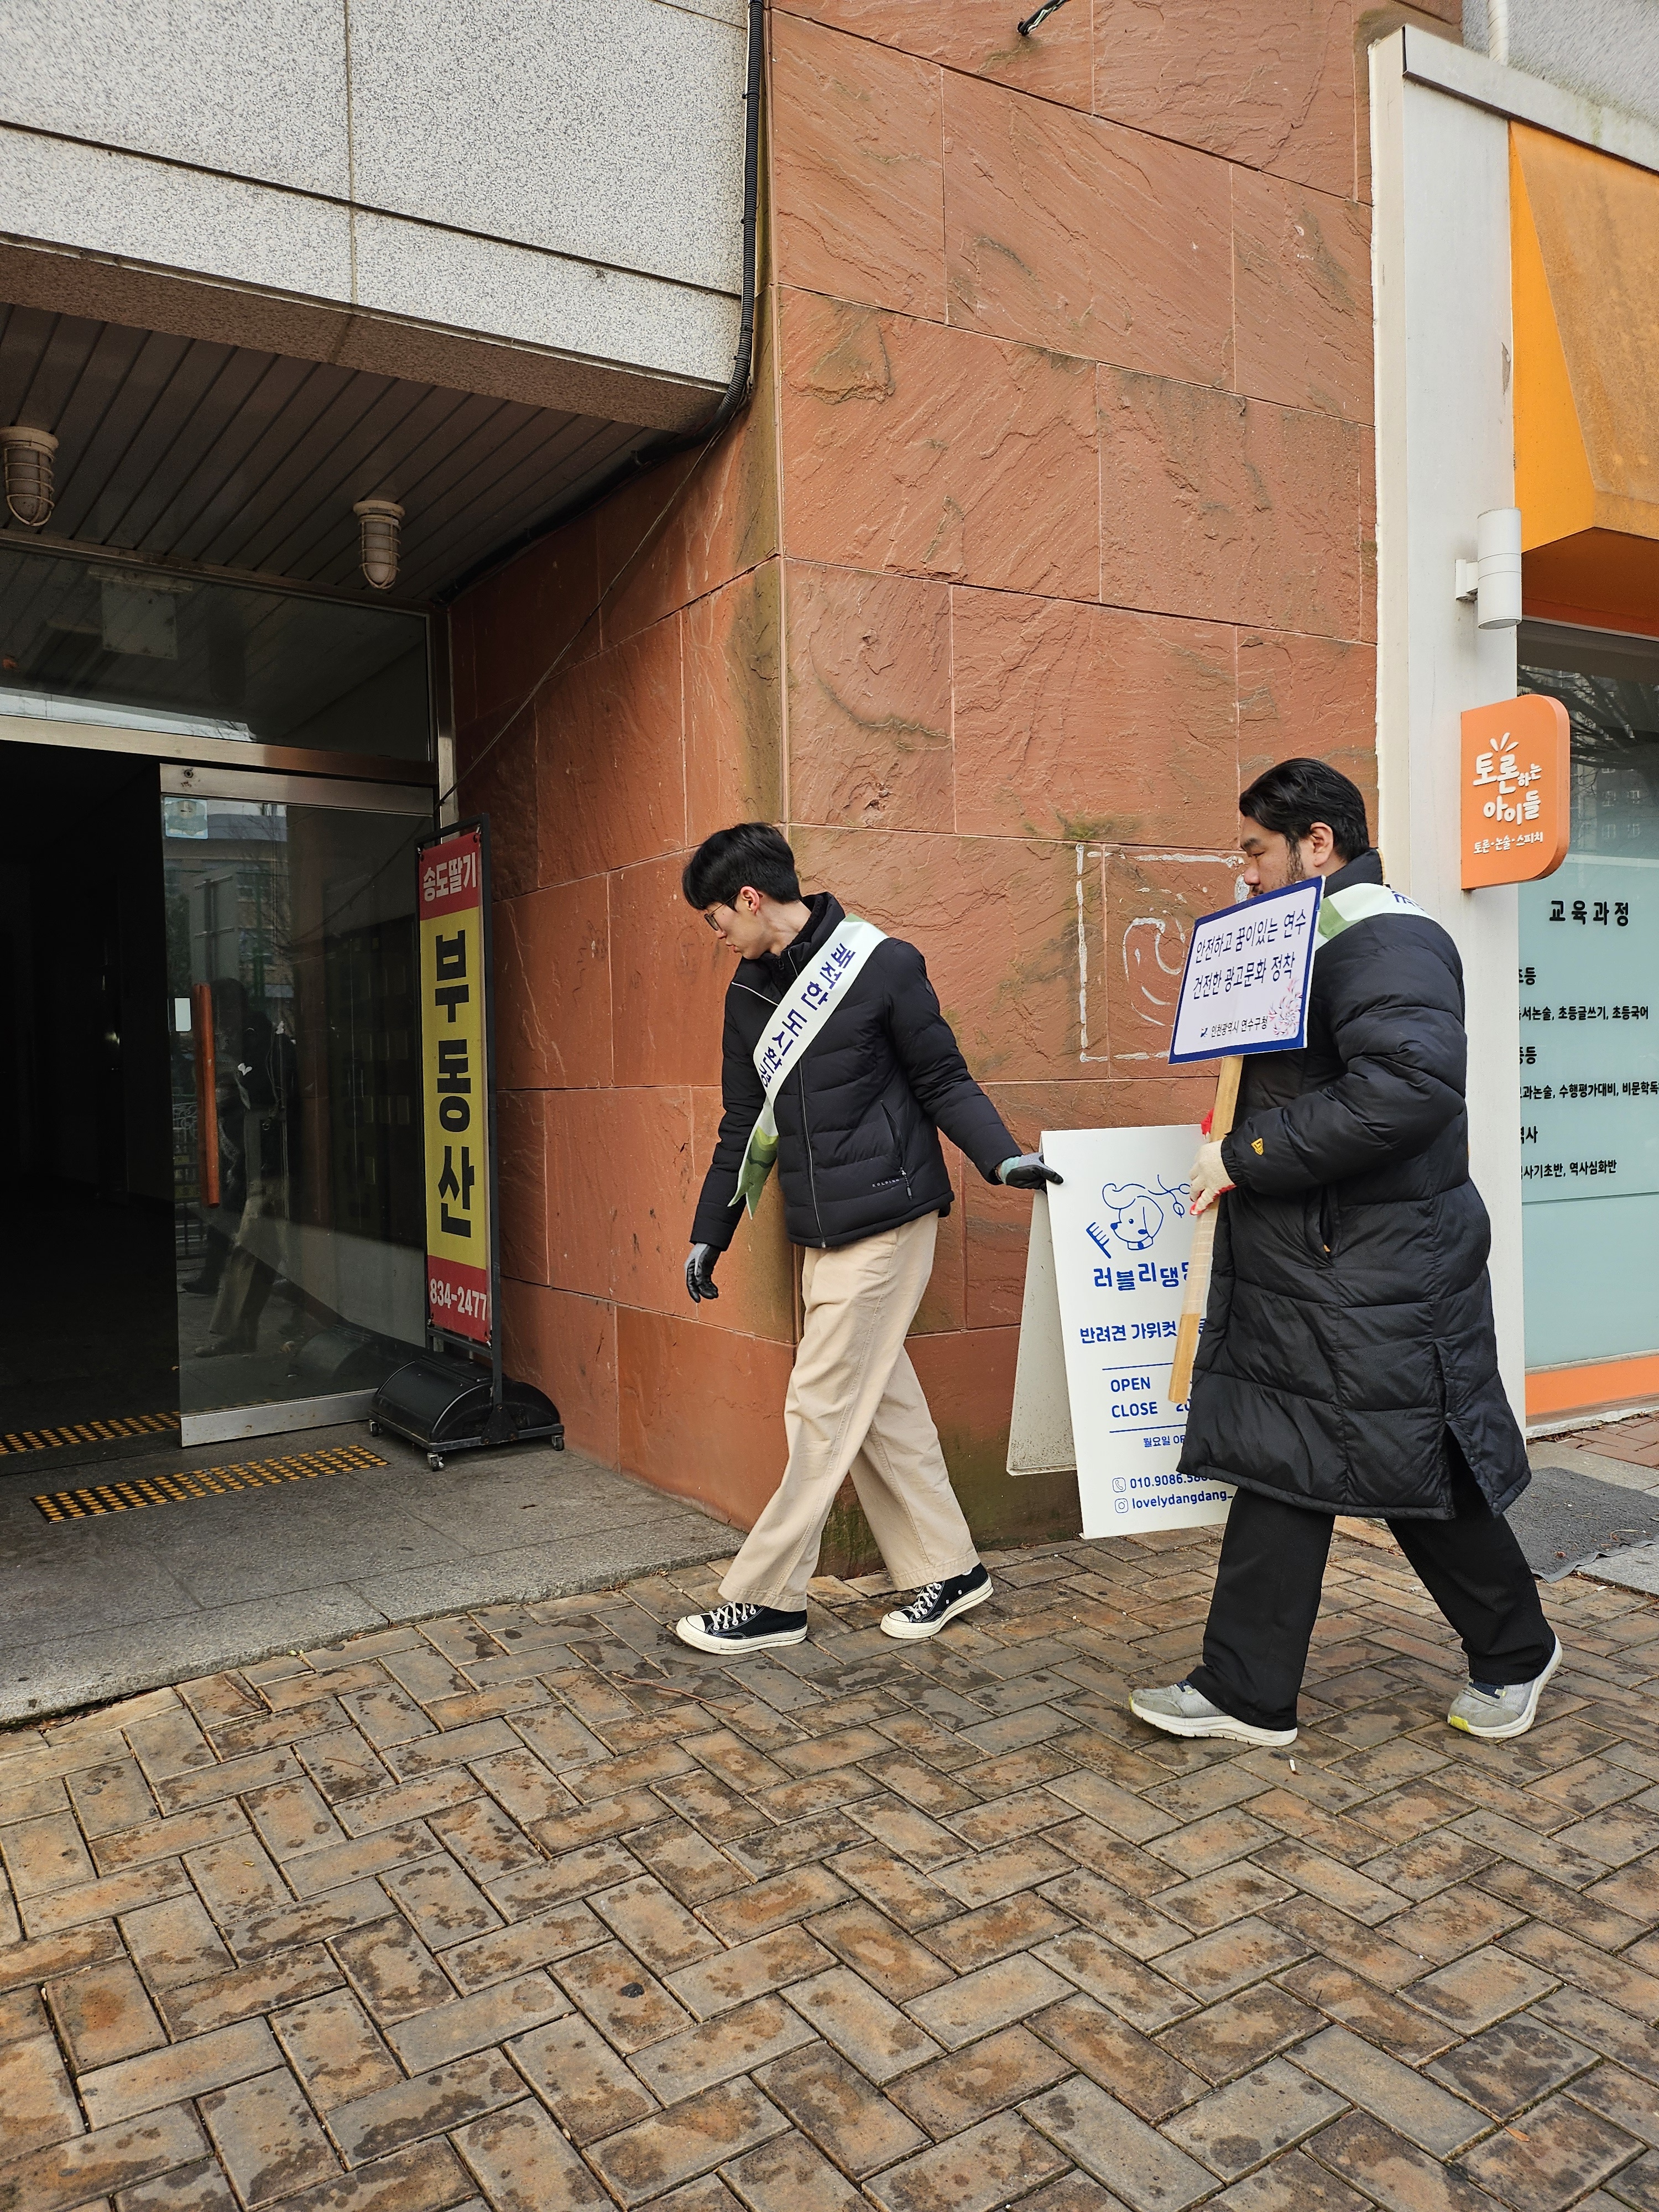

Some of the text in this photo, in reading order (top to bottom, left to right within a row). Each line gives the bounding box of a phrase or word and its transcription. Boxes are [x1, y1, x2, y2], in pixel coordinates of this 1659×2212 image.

[1473, 752, 1542, 794] 토론하는
[1483, 790, 1541, 825] 아이들
[423, 852, 477, 902] 송도딸기
[1196, 932, 1232, 963] 안전하고
[1284, 909, 1306, 938] 연수
[1193, 951, 1295, 999] 건전한 광고문화 정착
[759, 942, 856, 1088] 쾌적한 도시환경
[1211, 1016, 1268, 1037] 인천광역시 연수구청
[1519, 1005, 1648, 1021] 서논술, 초등글쓰기, 초등국어
[435, 930, 474, 1238] 부동산
[1520, 1081, 1659, 1099] 과논술, 수행평가대비, 비문학독
[1521, 1159, 1618, 1180] 사기초반, 역사심화반
[430, 1278, 487, 1321] 834-2477
[1080, 1324, 1126, 1344] 반려견
[1110, 1377, 1151, 1392] OPEN
[1112, 1401, 1158, 1418] CLOSE
[1144, 1436, 1171, 1447] 월요일
